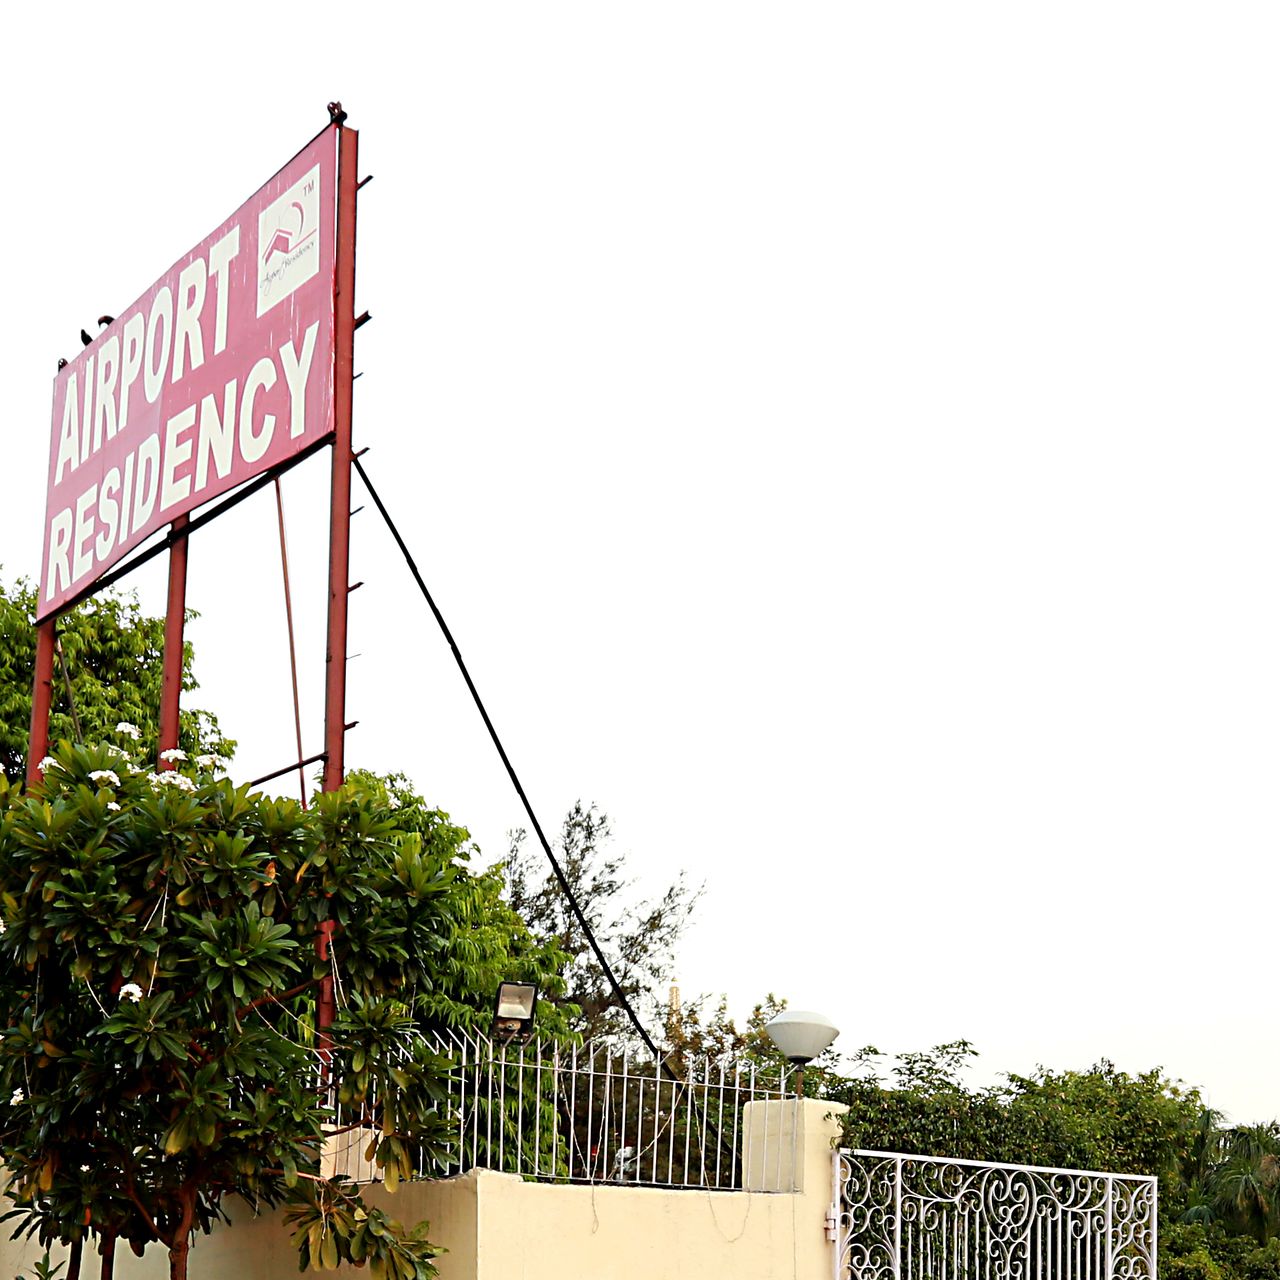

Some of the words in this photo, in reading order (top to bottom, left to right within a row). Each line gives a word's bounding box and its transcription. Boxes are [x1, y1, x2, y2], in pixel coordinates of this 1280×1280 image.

[303, 179, 315, 197] TM
[45, 320, 319, 601] RESIDENCY
[54, 224, 240, 487] AIRPORT
